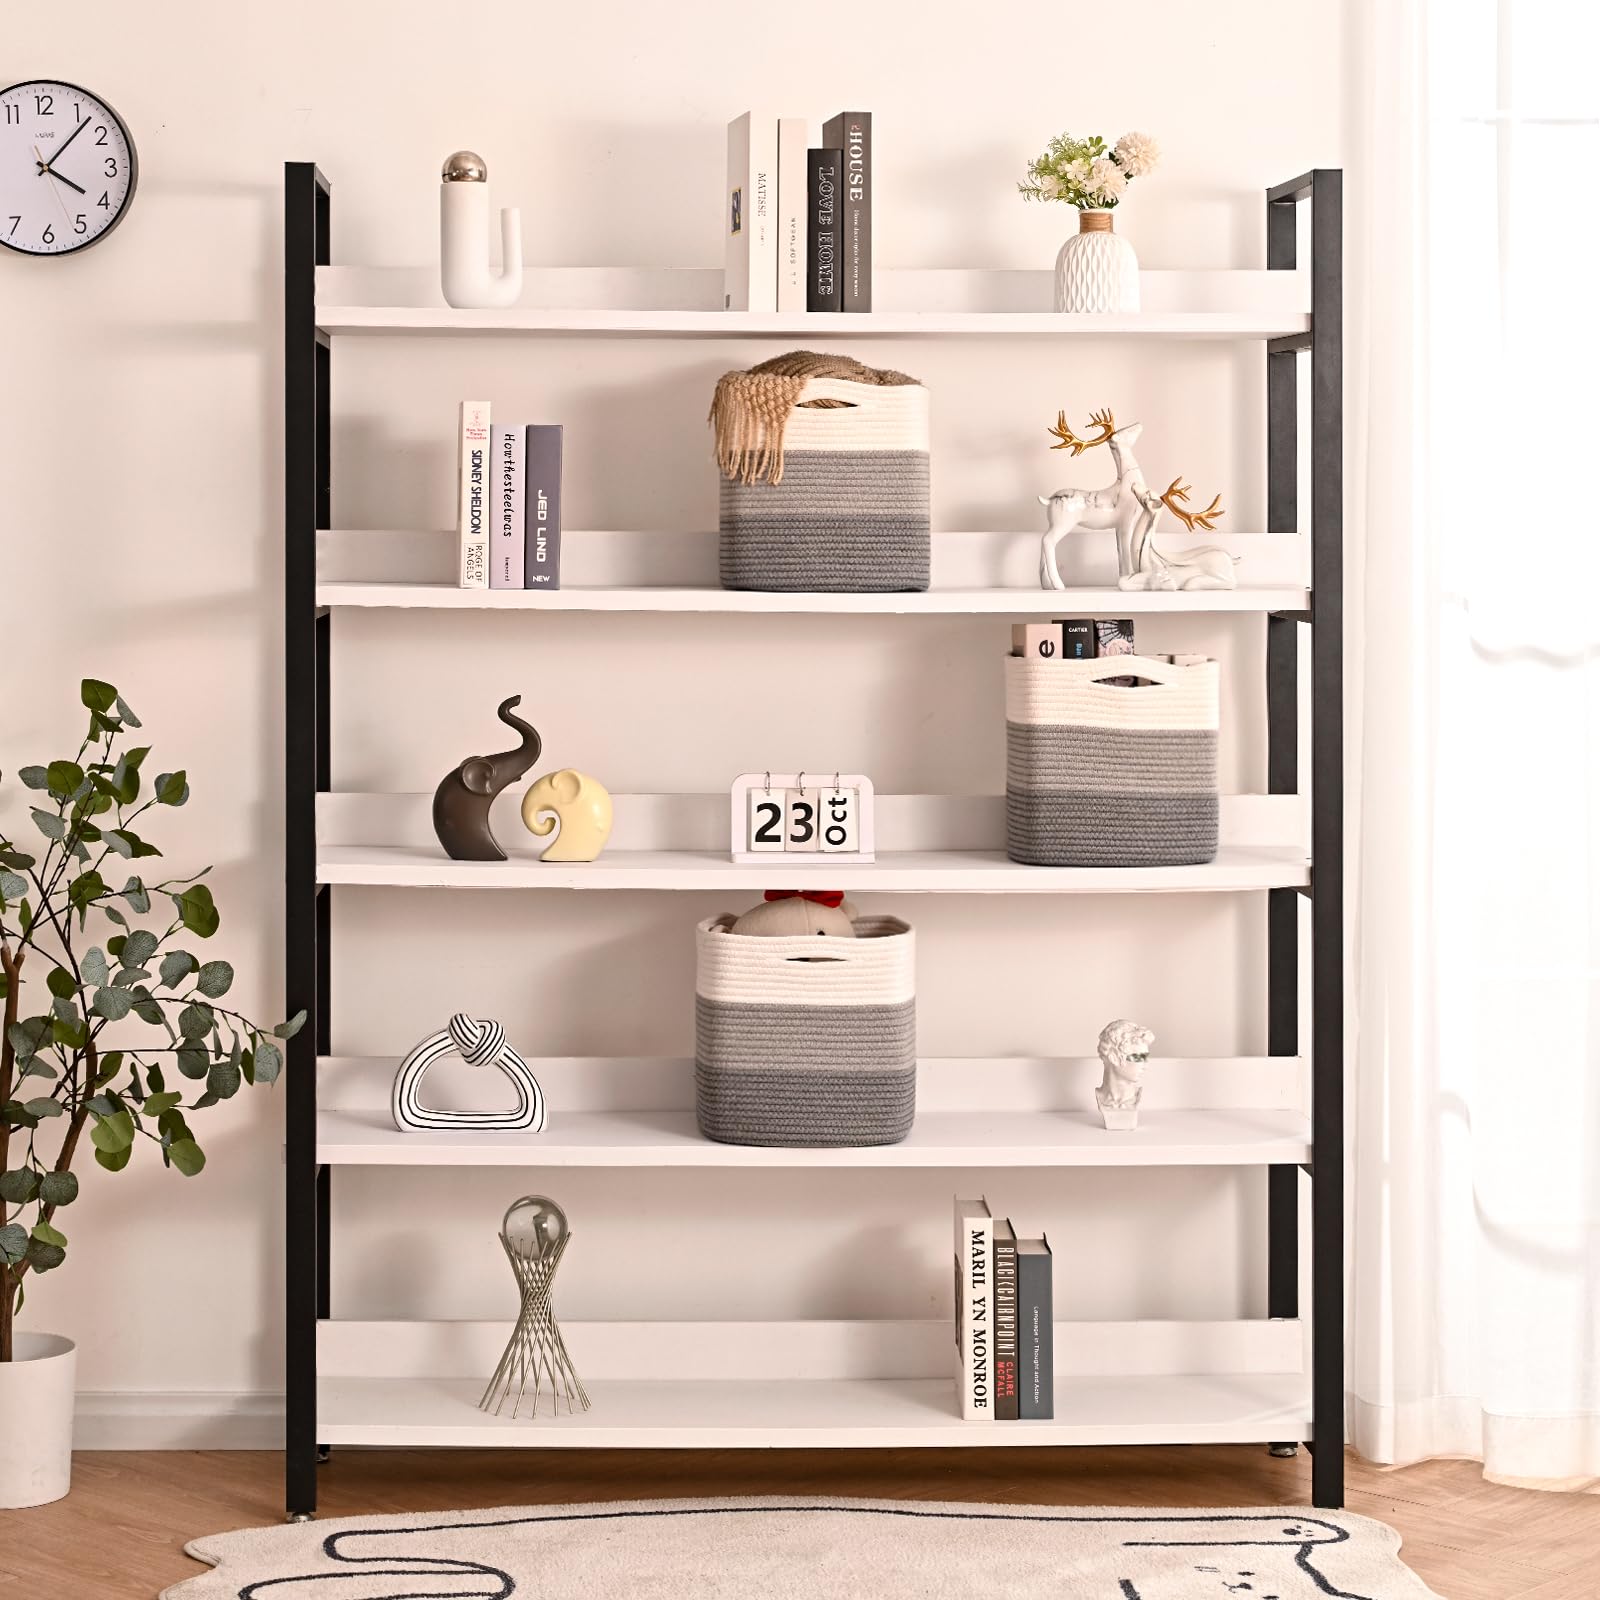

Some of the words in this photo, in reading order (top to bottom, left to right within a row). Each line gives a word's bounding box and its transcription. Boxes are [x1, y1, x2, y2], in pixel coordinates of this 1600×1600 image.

[4, 105, 20, 125] 11
[35, 96, 54, 115] 12
[74, 103, 79, 123] 1
[95, 126, 108, 145] 2
[105, 158, 117, 178] 3
[849, 132, 863, 201] HOUSE
[97, 191, 110, 210] 4
[758, 173, 766, 216] MATISSE
[819, 167, 834, 225] LOVE
[9, 216, 21, 236] 7
[42, 224, 54, 244] 6
[74, 214, 86, 234] 5
[819, 232, 833, 294] HOME
[472, 450, 482, 484] SIDNEY
[504, 434, 515, 537] Howthesteelwas
[471, 487, 481, 534] SHELDON
[538, 490, 547, 520] JED
[537, 528, 546, 562] LIND
[466, 547, 474, 580] ANGELS
[475, 571, 483, 583] OF
[825, 797, 847, 845] Oct
[972, 1231, 985, 1288] MARIL
[973, 1297, 986, 1321] YN
[973, 1329, 987, 1408] MONROE
[1006, 1362, 1014, 1396] CLAIRE
